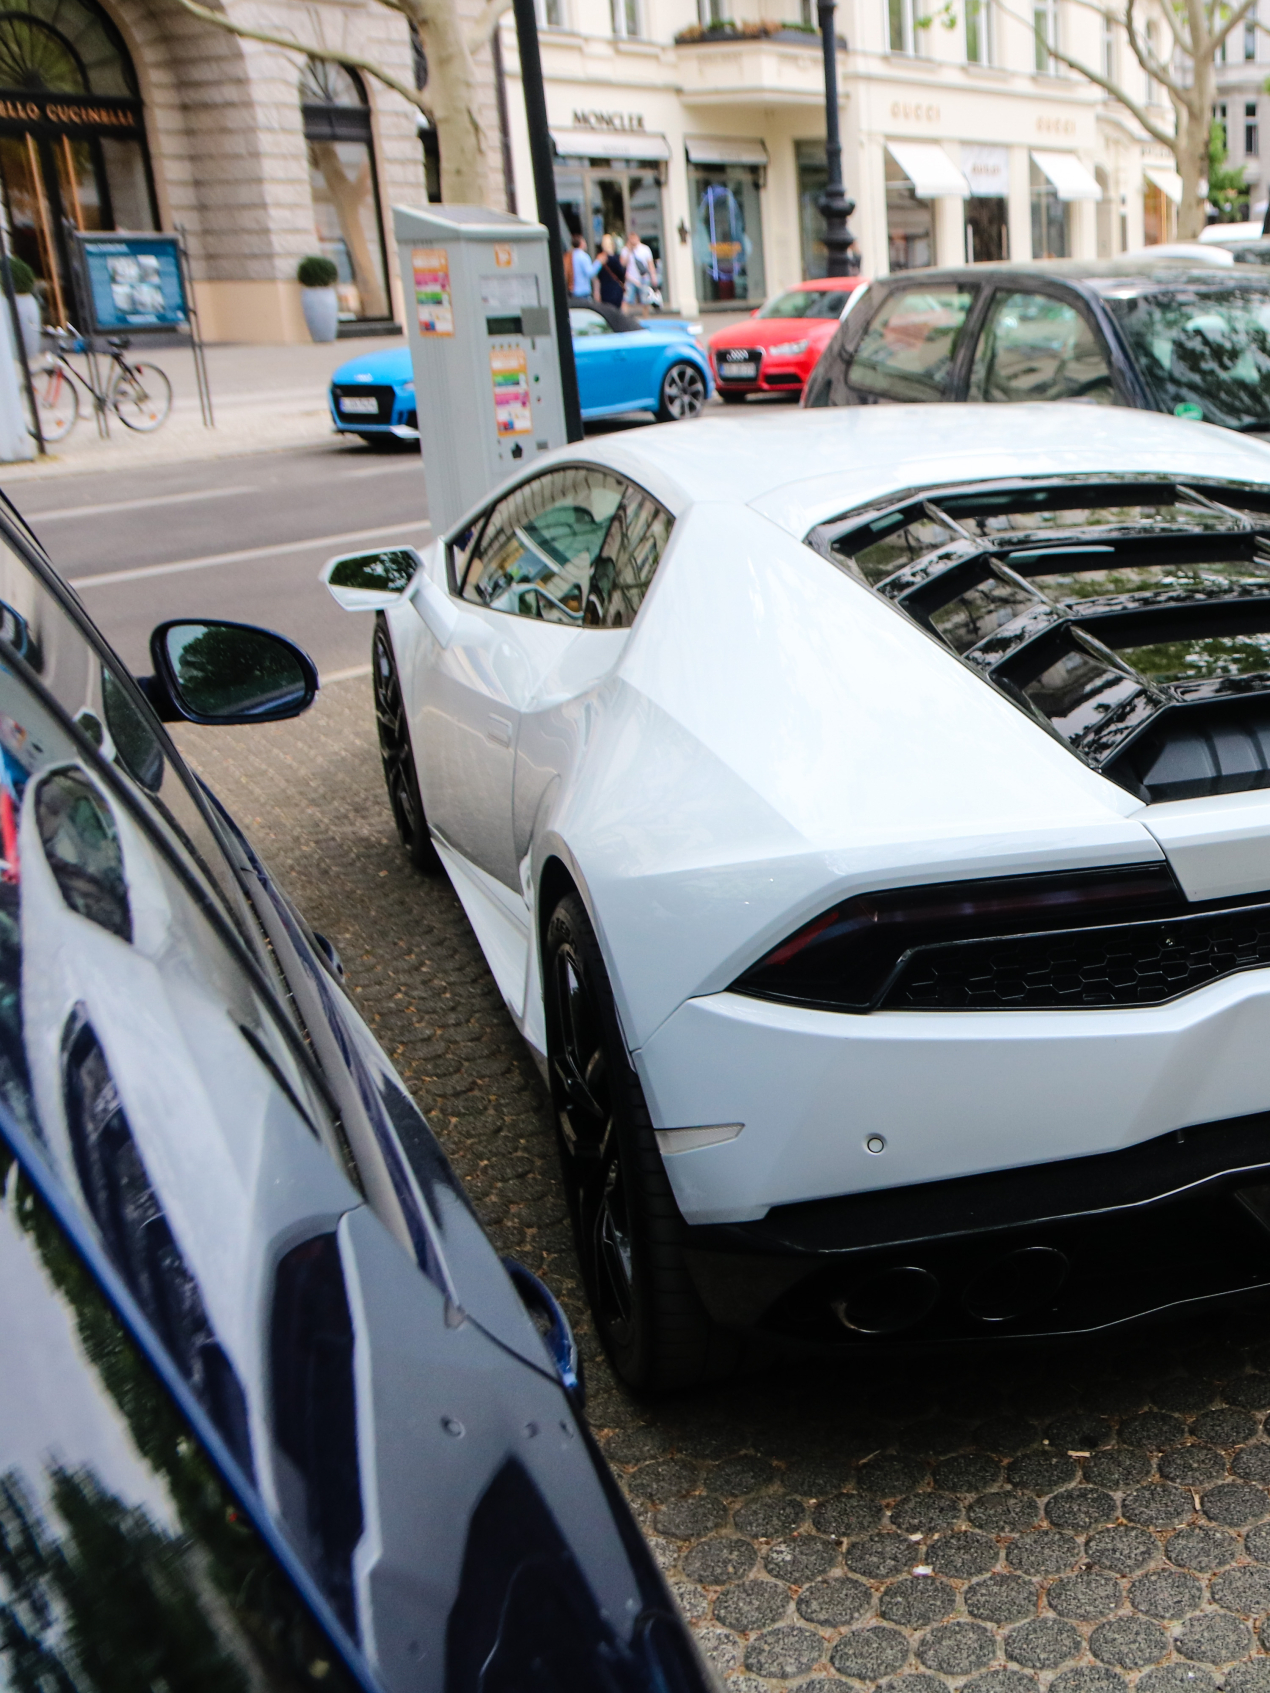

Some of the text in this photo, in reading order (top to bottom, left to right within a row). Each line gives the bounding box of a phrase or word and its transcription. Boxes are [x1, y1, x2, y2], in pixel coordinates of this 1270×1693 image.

[572, 108, 647, 132] MONCLER
[890, 102, 941, 122] GUCCI
[1036, 116, 1076, 134] GUCCI
